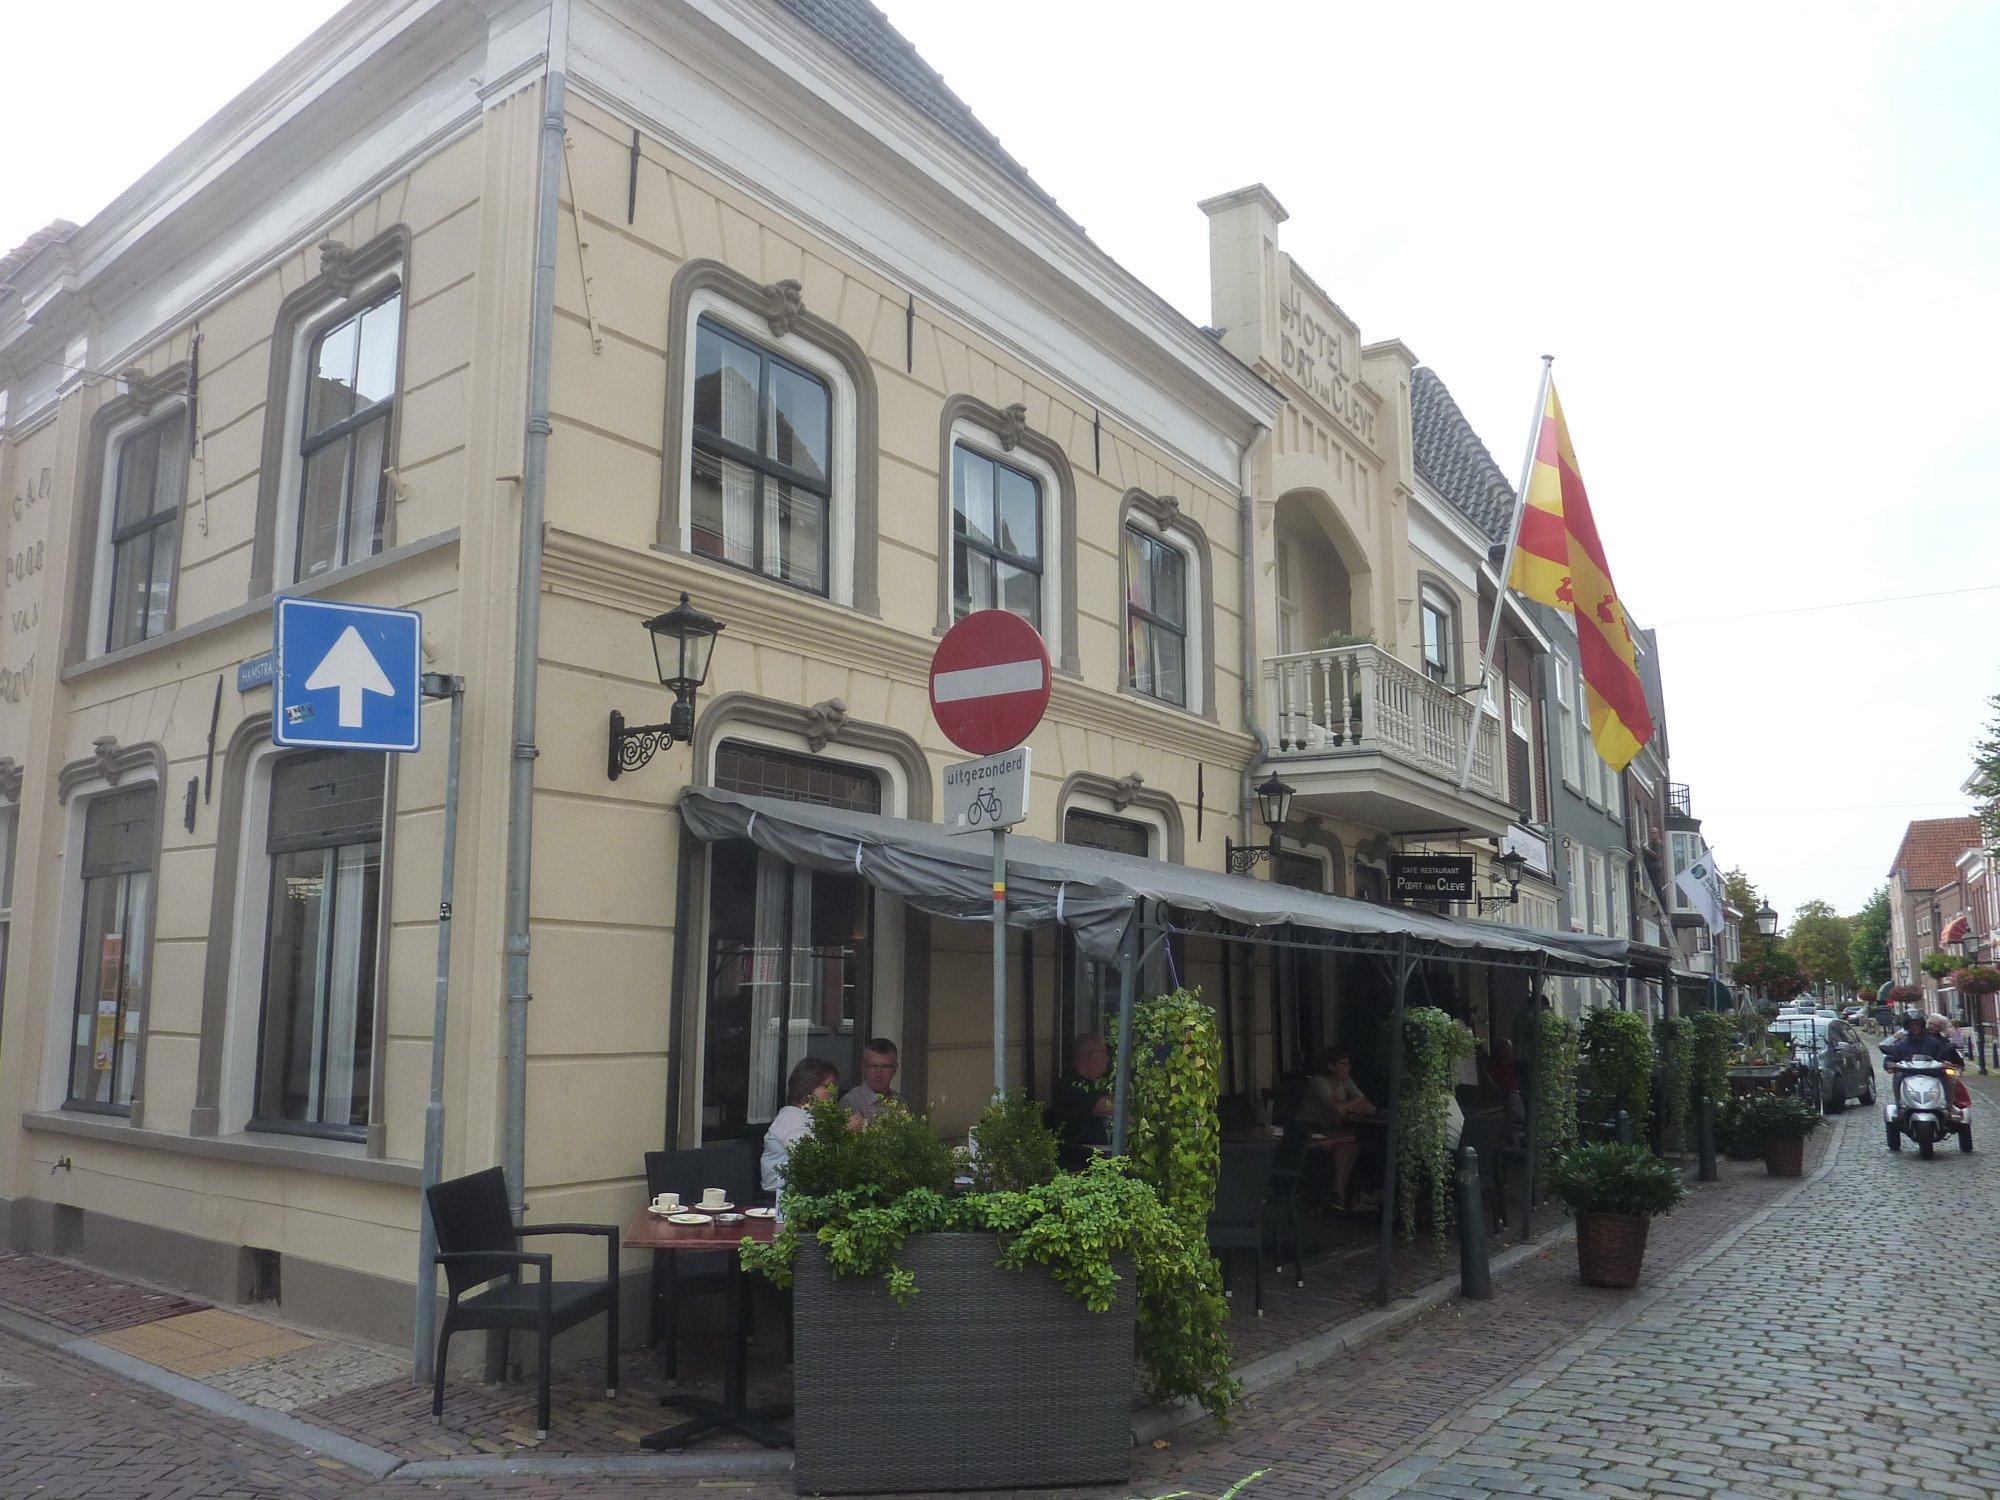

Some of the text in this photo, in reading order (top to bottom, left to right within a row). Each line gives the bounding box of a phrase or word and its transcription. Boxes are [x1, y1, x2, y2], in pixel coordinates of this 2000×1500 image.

[1290, 284, 1350, 383] HOTEL
[1331, 374, 1376, 445] CLEVE
[947, 755, 1023, 786] uitgezonderd
[1420, 867, 1460, 875] RESTAURANT
[1437, 877, 1466, 891] CLEVE
